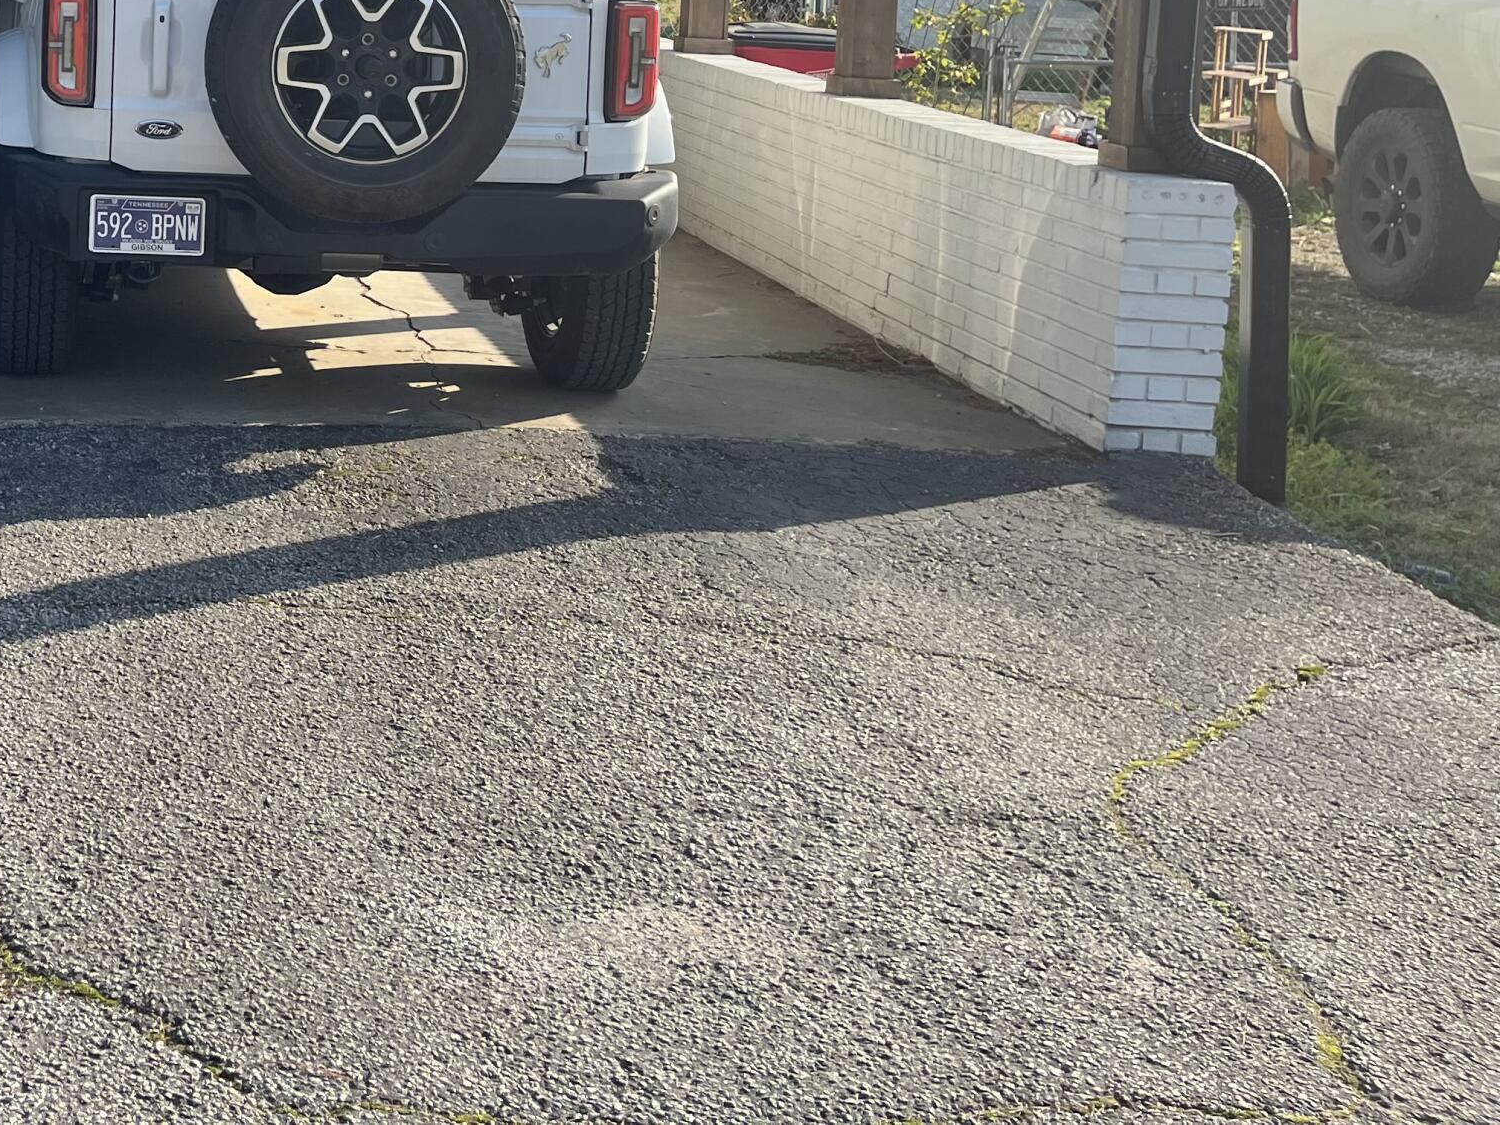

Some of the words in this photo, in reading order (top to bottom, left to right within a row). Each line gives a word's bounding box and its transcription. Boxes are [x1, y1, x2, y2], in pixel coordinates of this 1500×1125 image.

[145, 123, 172, 135] Ford
[128, 201, 169, 209] TENNESSEE
[97, 212, 133, 238] 592
[151, 213, 199, 241] BPNW
[131, 243, 164, 251] GIBSON
